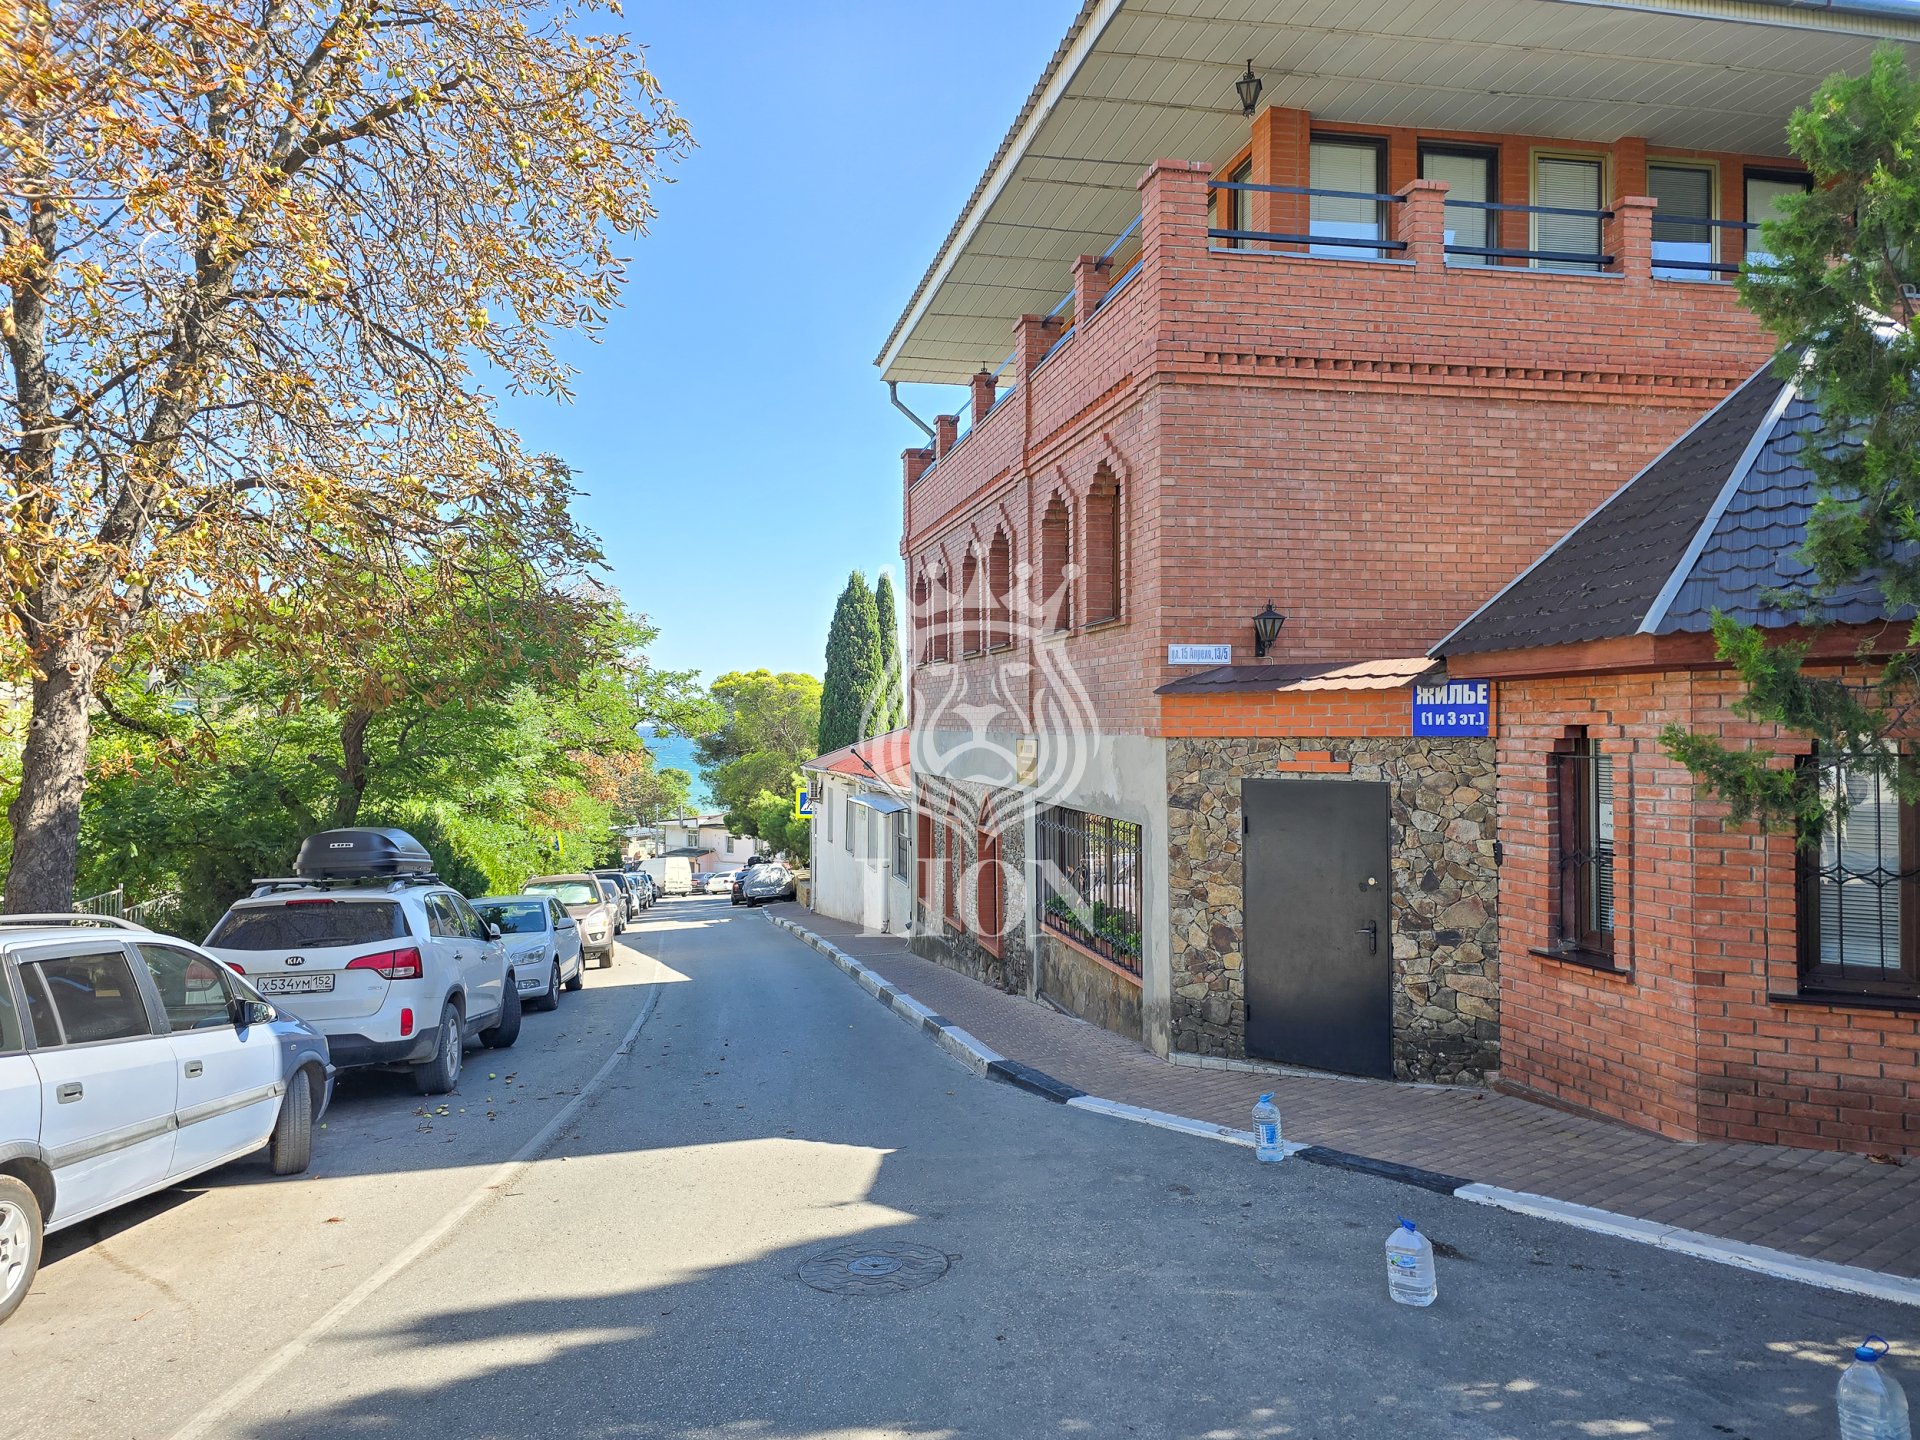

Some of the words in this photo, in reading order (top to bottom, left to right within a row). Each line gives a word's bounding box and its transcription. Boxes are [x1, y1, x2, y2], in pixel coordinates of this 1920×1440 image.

[1181, 648, 1188, 660] 15
[1214, 648, 1228, 660] 13/5
[1416, 684, 1488, 705] ЖИЛЬЕ
[1421, 711, 1432, 726] (1
[1435, 713, 1445, 726] и
[1447, 711, 1457, 726] 3
[1459, 711, 1485, 726] эт.)
[287, 957, 304, 965] KIA
[312, 976, 331, 986] 152
